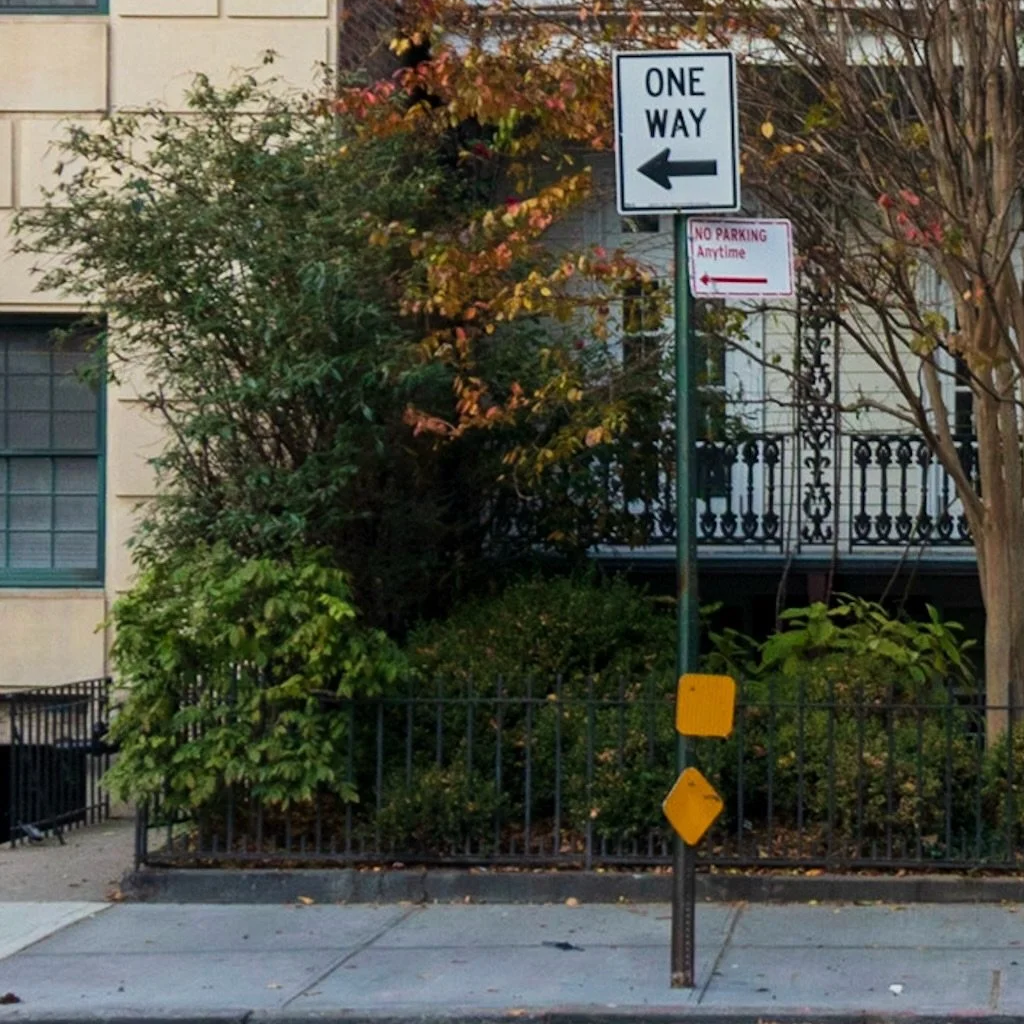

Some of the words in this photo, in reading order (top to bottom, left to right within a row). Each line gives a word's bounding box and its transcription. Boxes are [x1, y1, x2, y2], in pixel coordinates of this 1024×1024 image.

[645, 67, 706, 97] ONE
[645, 108, 707, 138] WAY
[695, 227, 712, 241] NO
[715, 227, 768, 242] PARKING
[697, 245, 746, 261] Anytime
